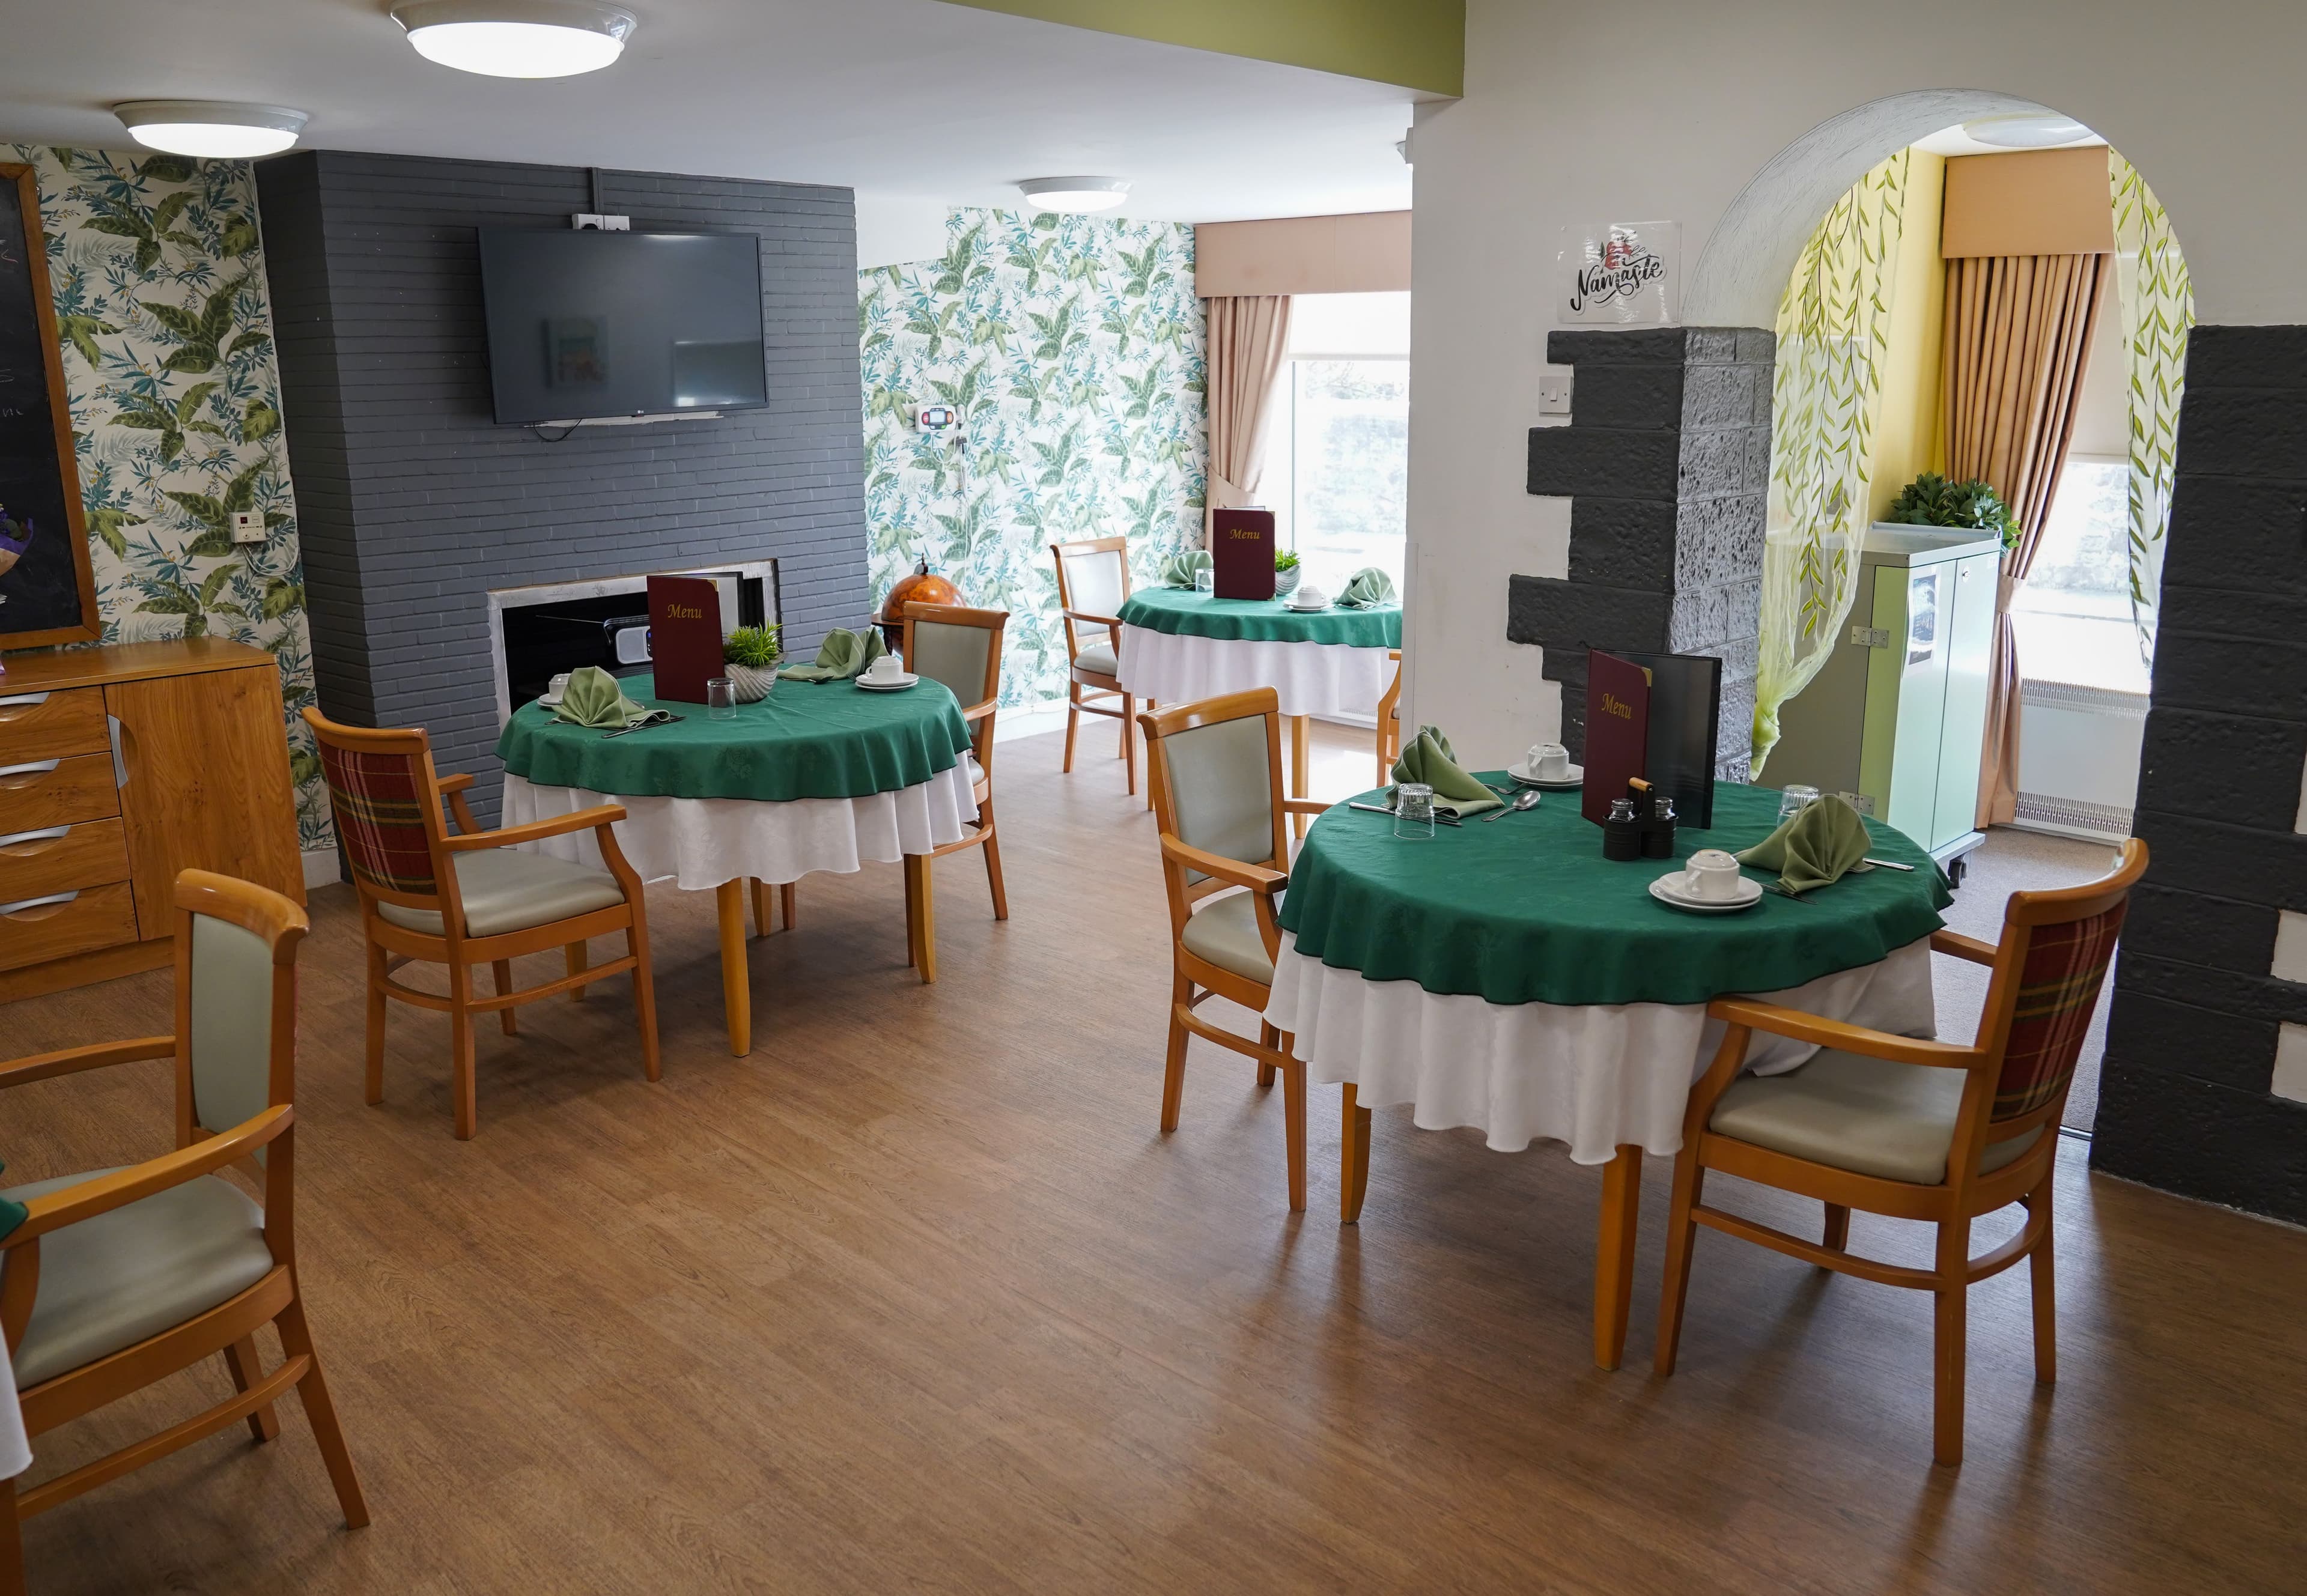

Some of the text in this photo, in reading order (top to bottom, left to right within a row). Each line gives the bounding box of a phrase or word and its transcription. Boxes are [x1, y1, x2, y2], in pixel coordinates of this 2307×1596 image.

[1570, 254, 1663, 311] Namaste
[1230, 529, 1260, 539] Menu
[667, 604, 702, 619] Menu
[1601, 693, 1632, 720] Menu
